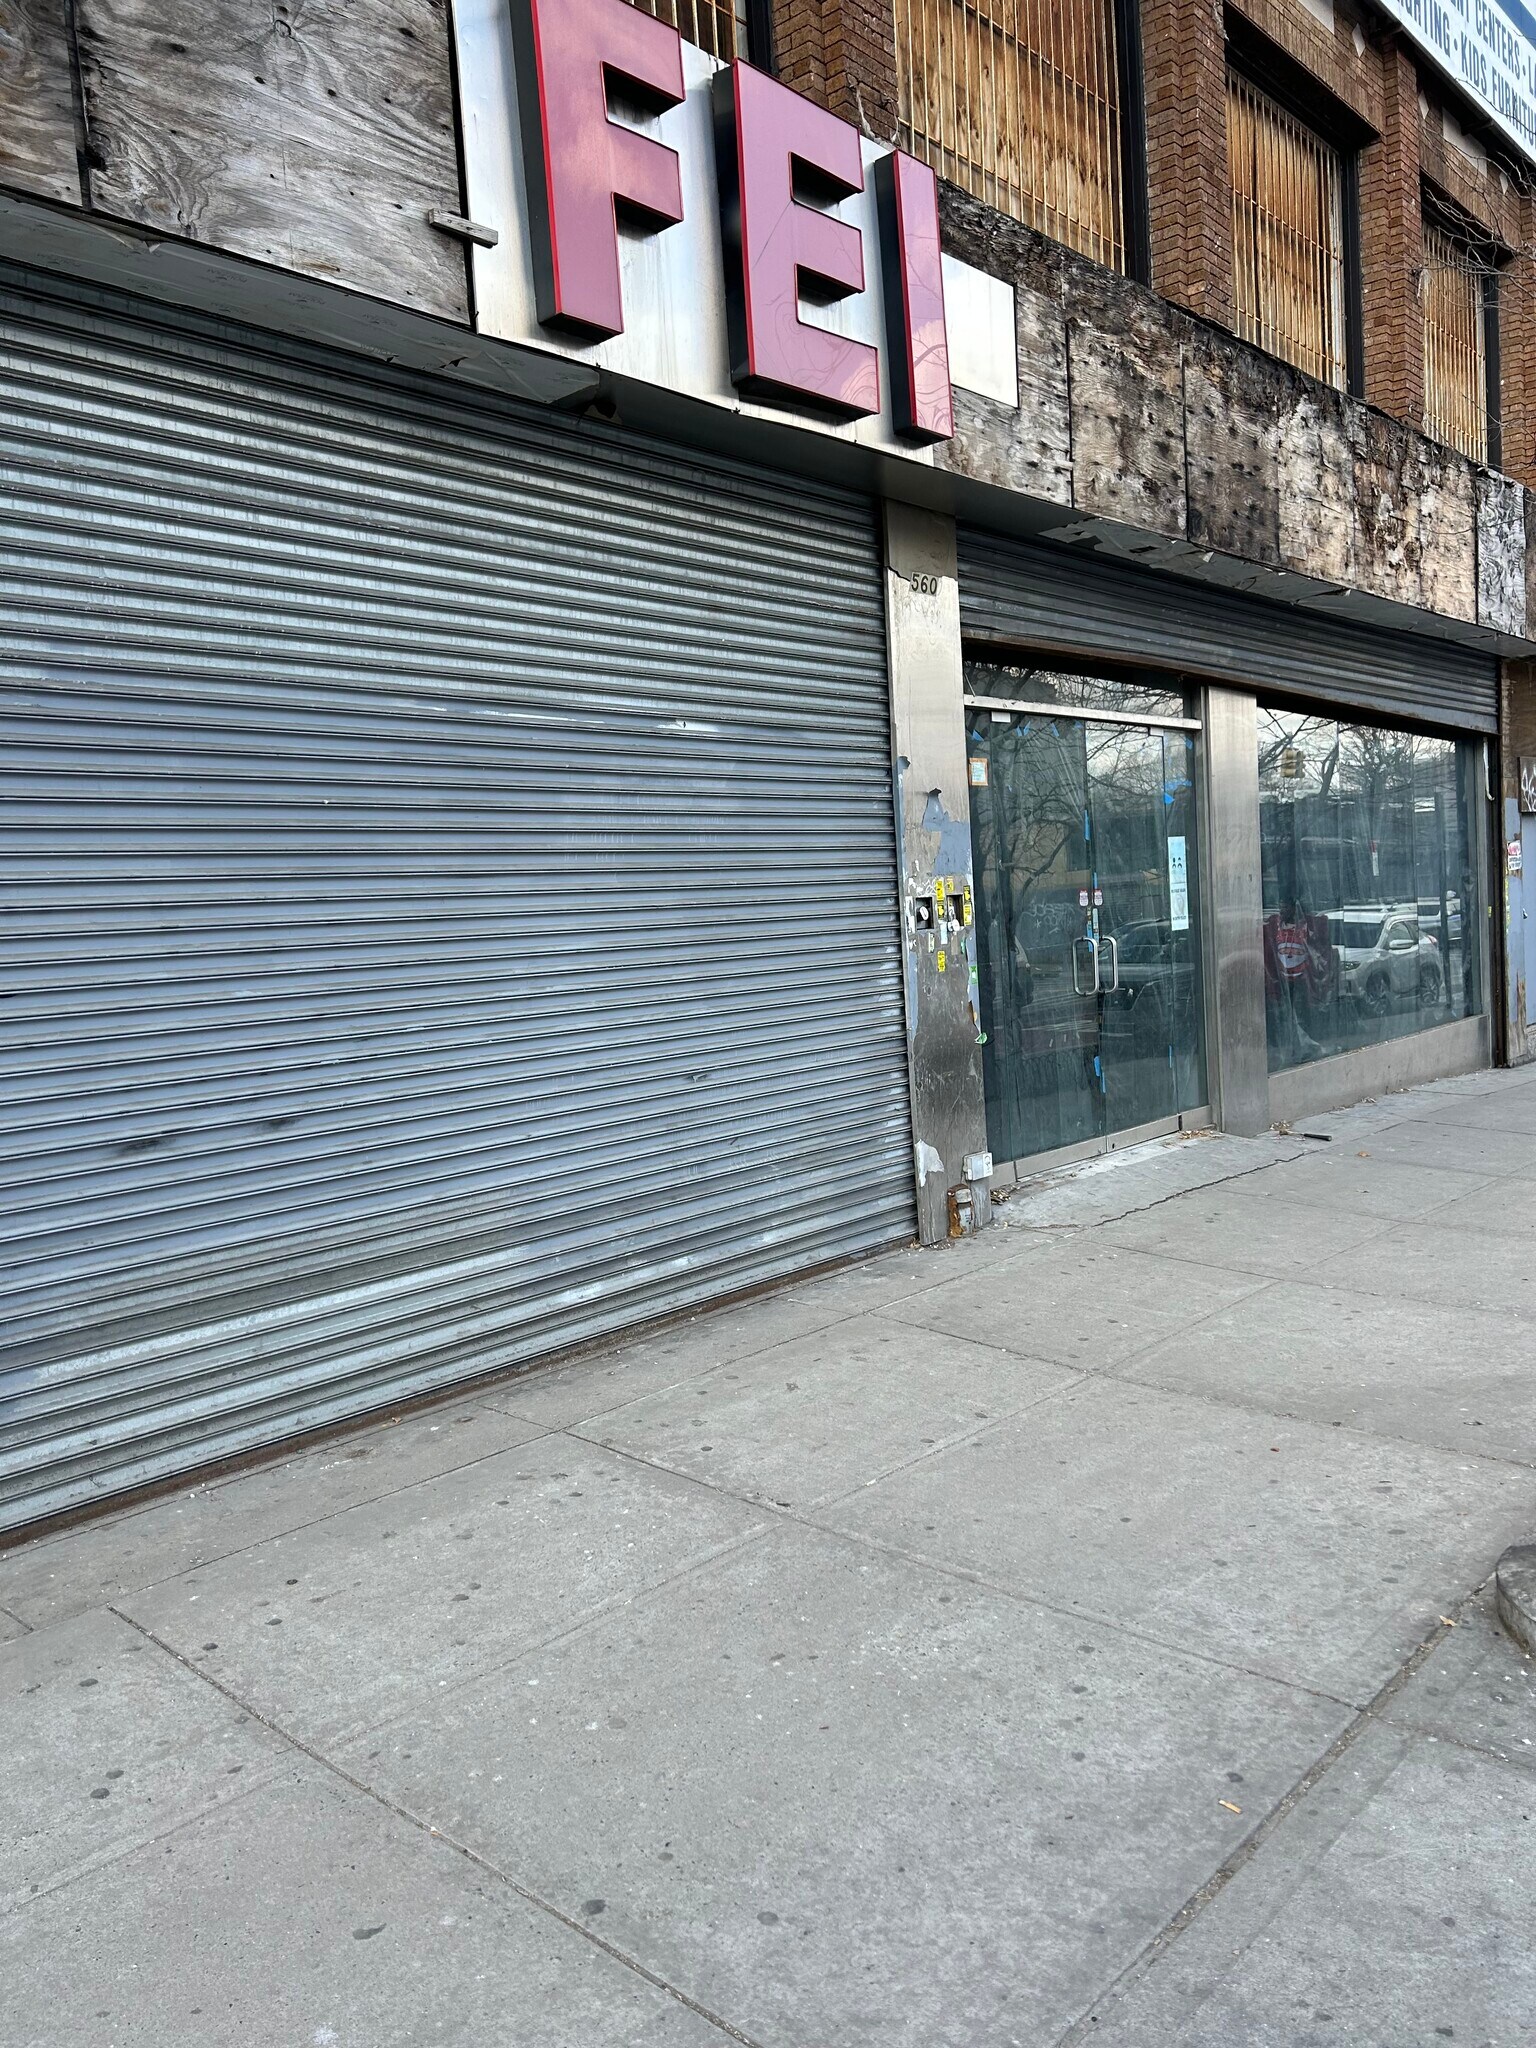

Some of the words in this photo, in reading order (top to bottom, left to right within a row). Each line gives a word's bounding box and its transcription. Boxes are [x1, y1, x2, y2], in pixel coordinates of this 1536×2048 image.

[1461, 30, 1487, 96] KIDS
[1492, 65, 1536, 150] FURNITU
[1475, 0, 1520, 80] CENTERS
[510, 0, 955, 446] FEI
[911, 573, 938, 596] 560
